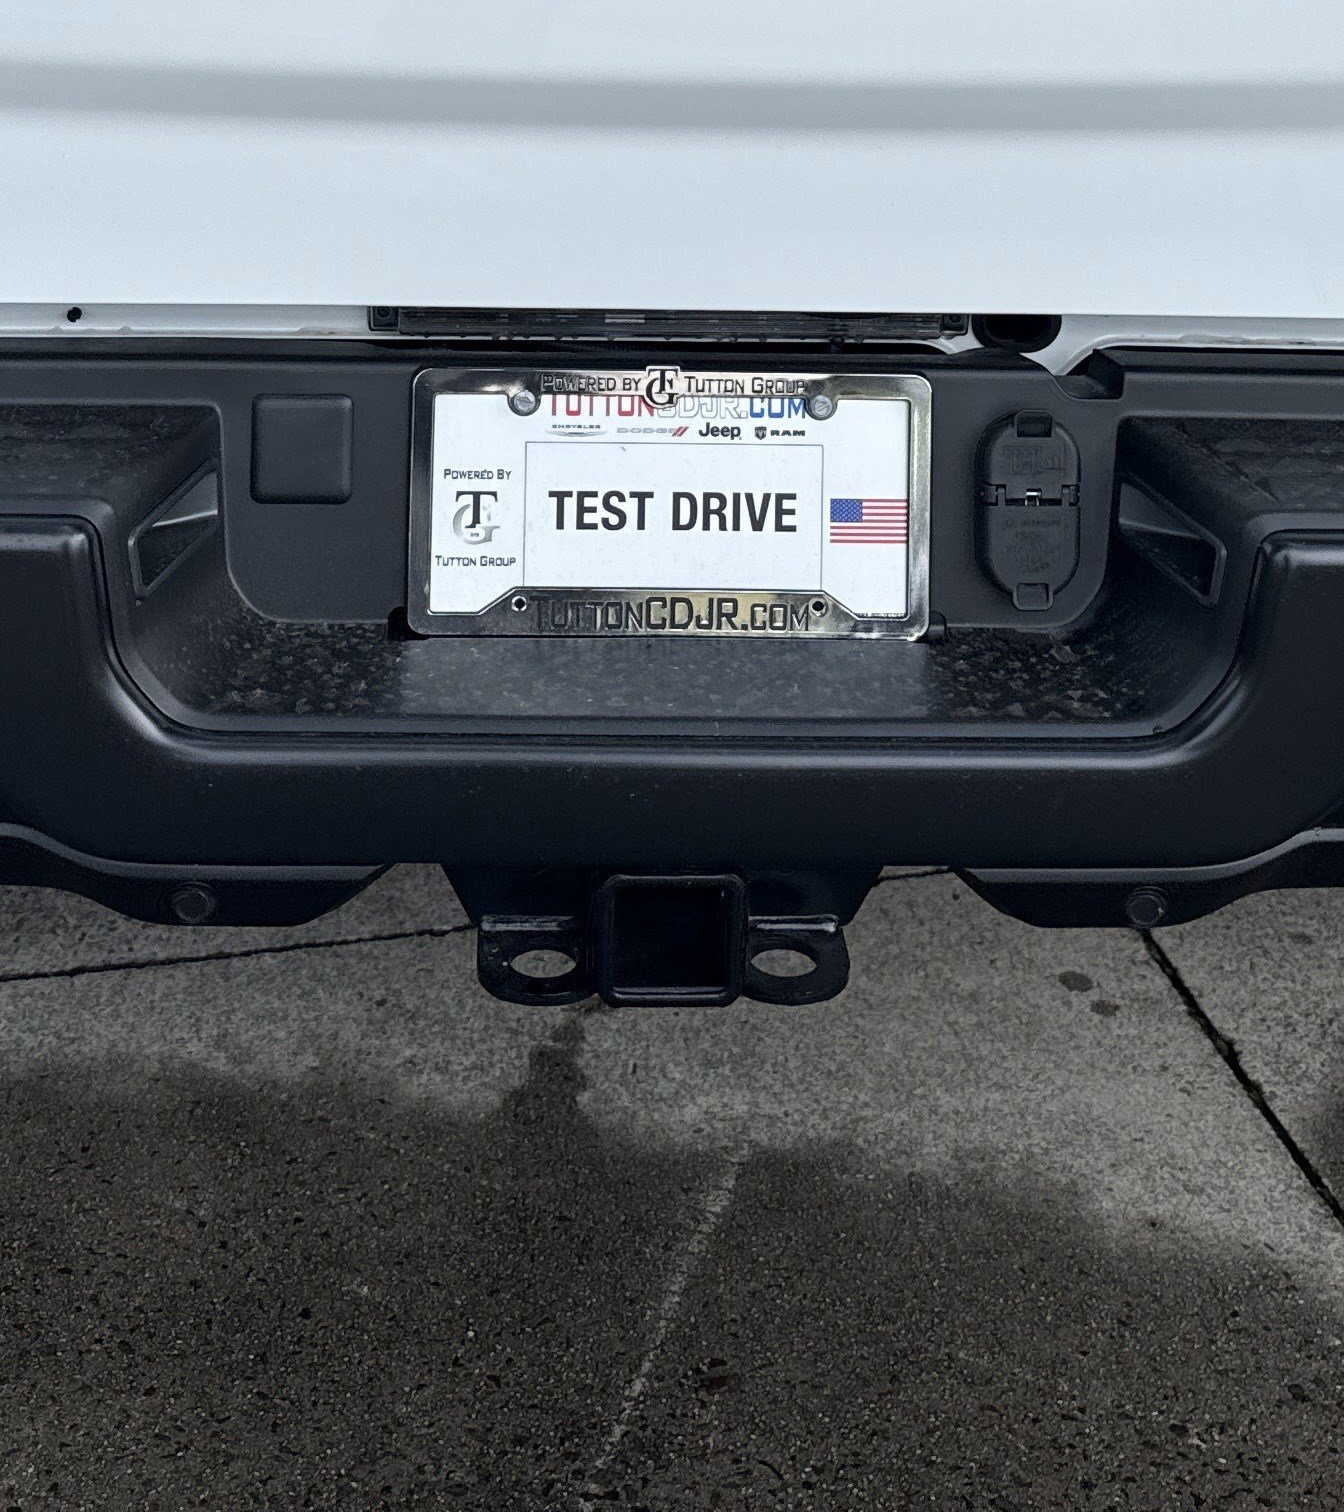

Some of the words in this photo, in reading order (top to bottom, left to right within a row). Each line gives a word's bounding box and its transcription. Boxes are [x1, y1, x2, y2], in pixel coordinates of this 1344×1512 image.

[541, 373, 617, 392] POWERED
[622, 376, 642, 392] BY
[684, 375, 745, 394] TUTTON
[751, 376, 806, 394] GROUP
[698, 421, 741, 440] Jeep
[770, 429, 806, 437] RAM
[443, 468, 494, 480] POWERED
[497, 468, 512, 480] BY
[548, 490, 655, 531] TEST
[672, 491, 797, 533] DRIVE
[435, 554, 477, 567] TUTTON
[479, 555, 517, 567] GROUP
